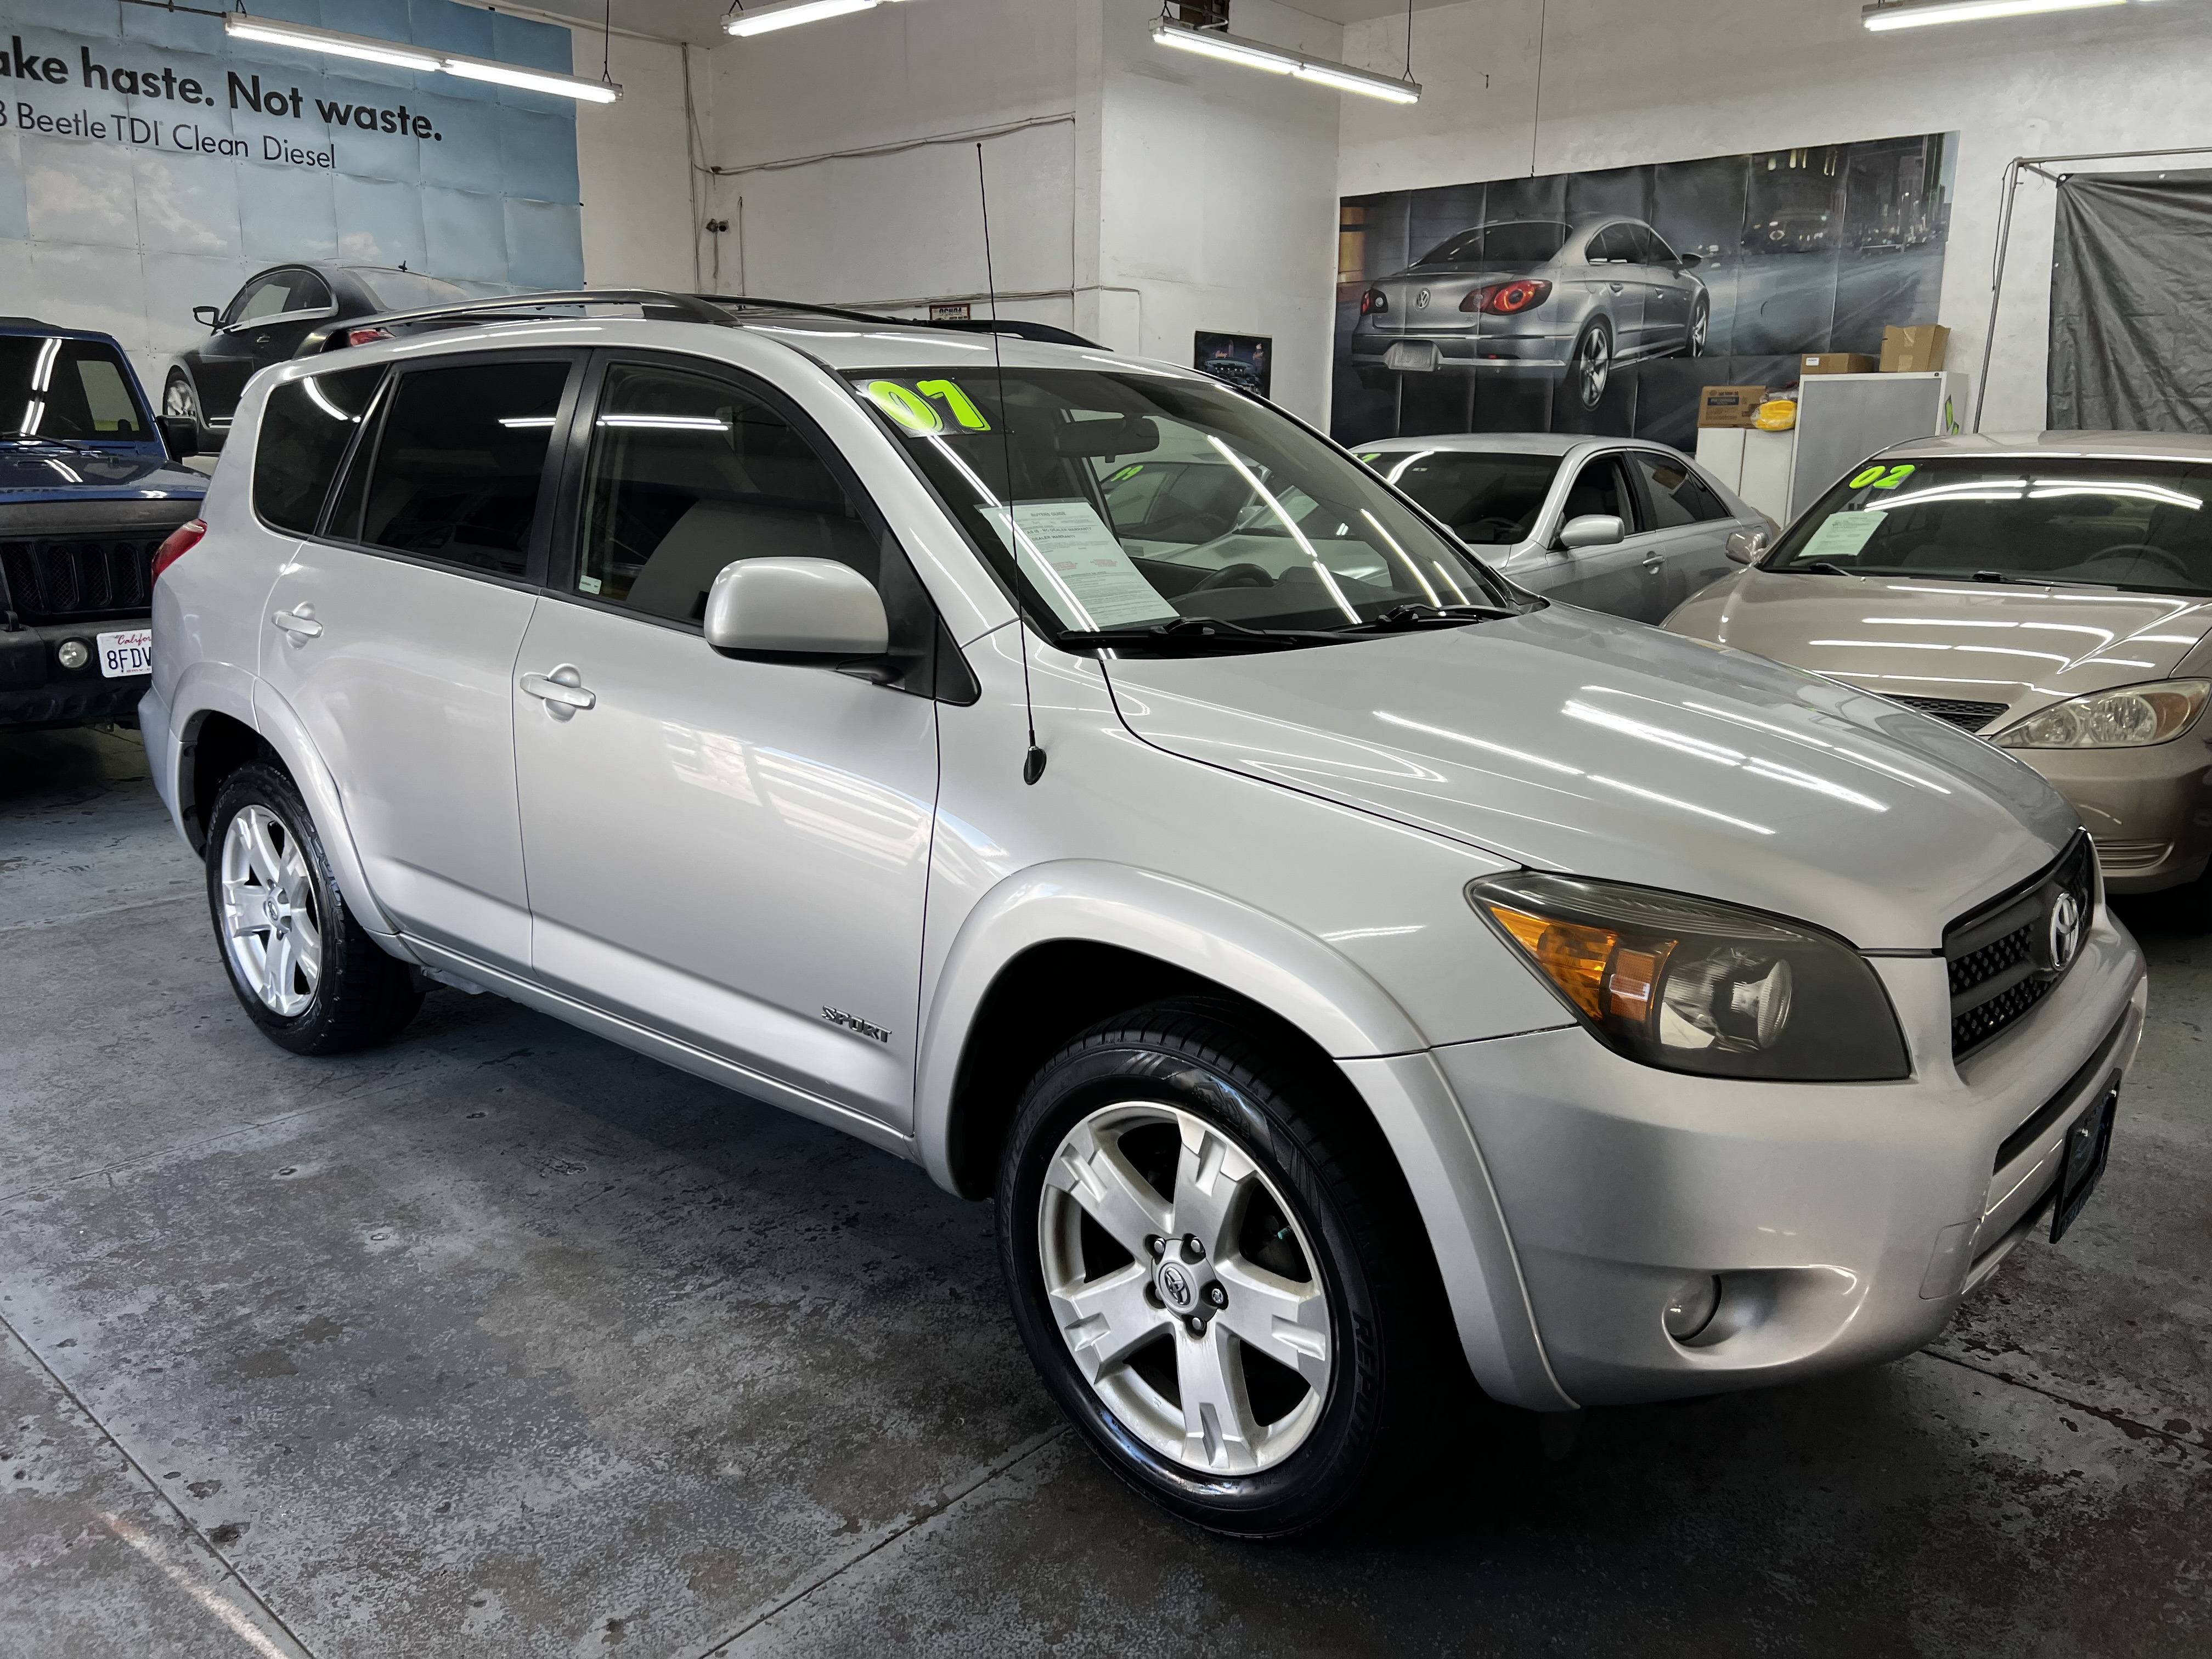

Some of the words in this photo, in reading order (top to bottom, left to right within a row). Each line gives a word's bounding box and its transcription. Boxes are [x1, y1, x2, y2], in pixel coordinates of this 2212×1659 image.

[80, 46, 215, 106] haste.
[227, 71, 303, 119] Not
[314, 98, 442, 142] waste.
[17, 102, 106, 138] Beetle
[172, 124, 249, 157] Clean
[263, 134, 336, 169] Diesel
[867, 379, 992, 432] 07
[1849, 464, 1915, 489] 02
[106, 646, 152, 670] 8FDV
[821, 1005, 892, 1043] SPORT
